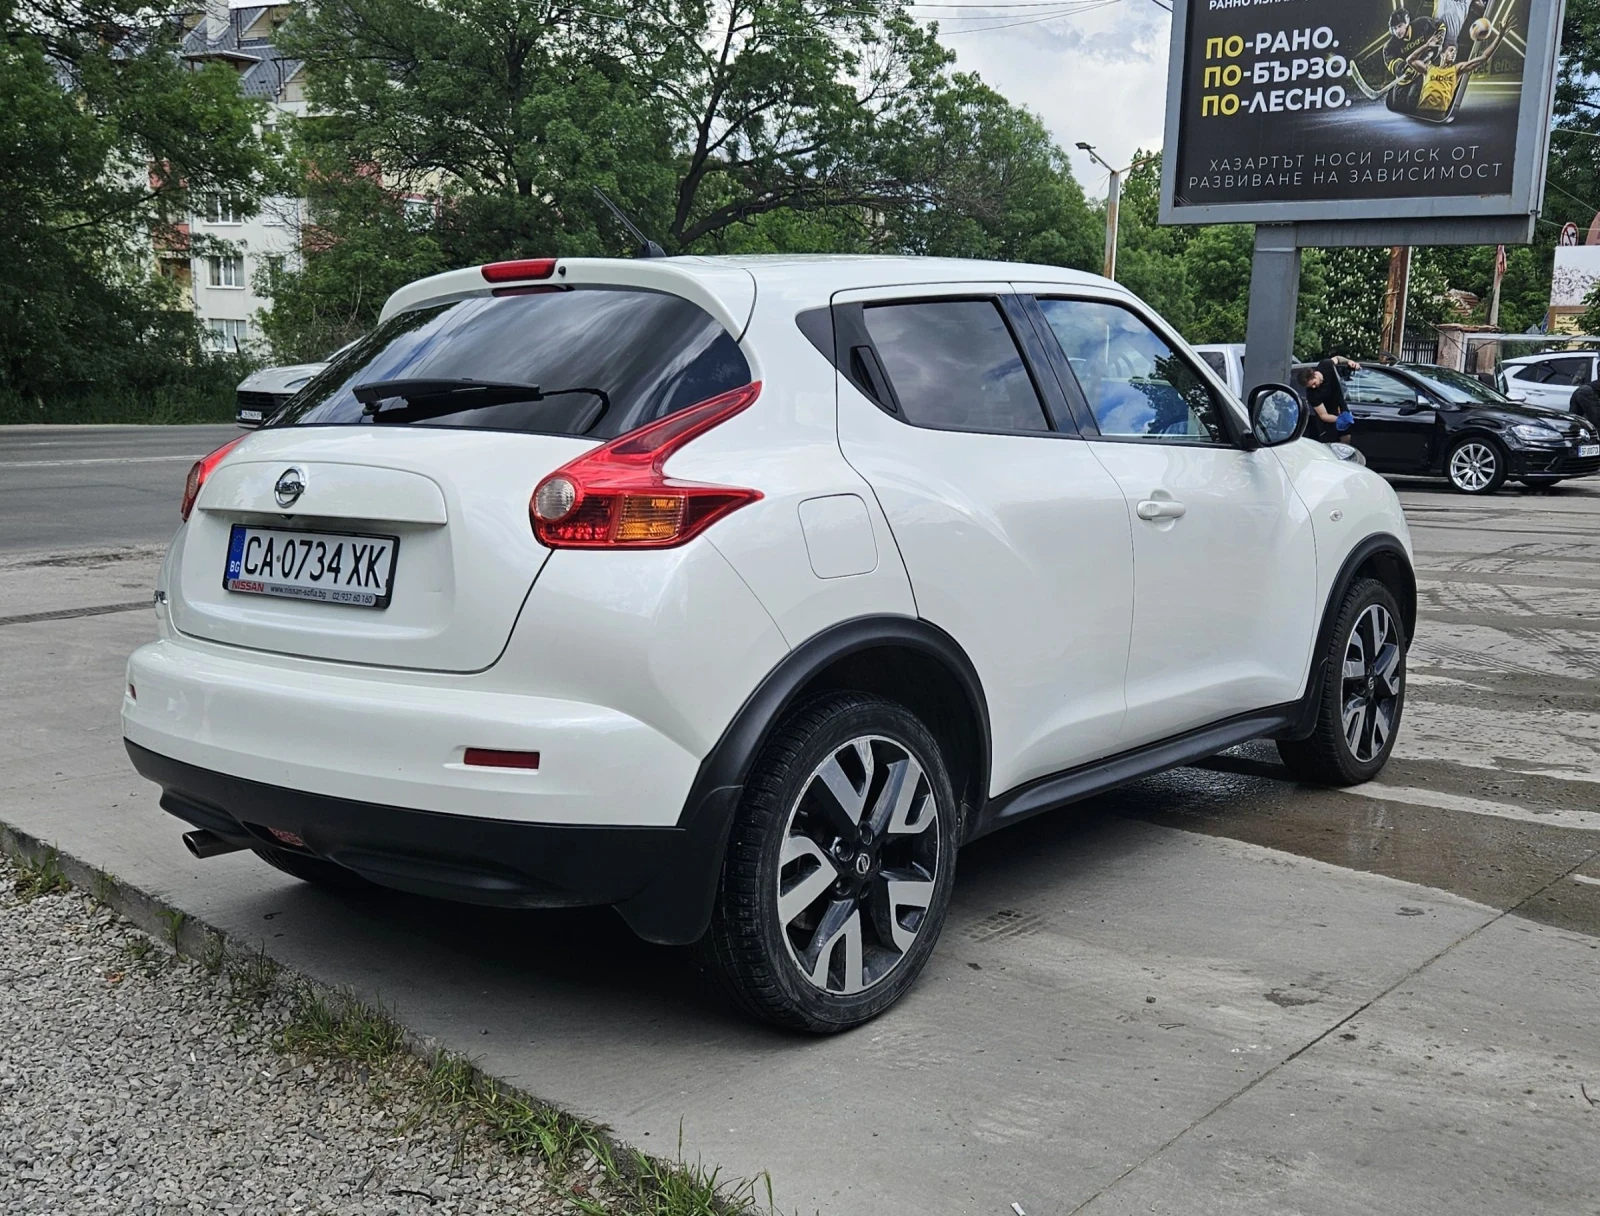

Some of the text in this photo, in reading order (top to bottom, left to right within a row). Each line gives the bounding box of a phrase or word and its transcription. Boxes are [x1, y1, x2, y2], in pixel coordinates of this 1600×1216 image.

[1205, 26, 1340, 60] ПО-РАНО.
[1204, 55, 1352, 88] ПО-БЪРЗО.
[1201, 85, 1352, 117] ПО-ЛЕСНО.
[1209, 145, 1481, 172] ХАЗАРТЪТ НОСИ РИСК ОТ
[1188, 162, 1503, 190] РАЗВИВАНЕ НА ЗАВИСИМОСТ
[229, 560, 241, 573] BG
[281, 539, 343, 584] 0734
[231, 580, 265, 593] NISSAN
[270, 586, 327, 599] www.nissan-sofia.bg
[353, 595, 361, 603] 60
[362, 595, 373, 604] 160
